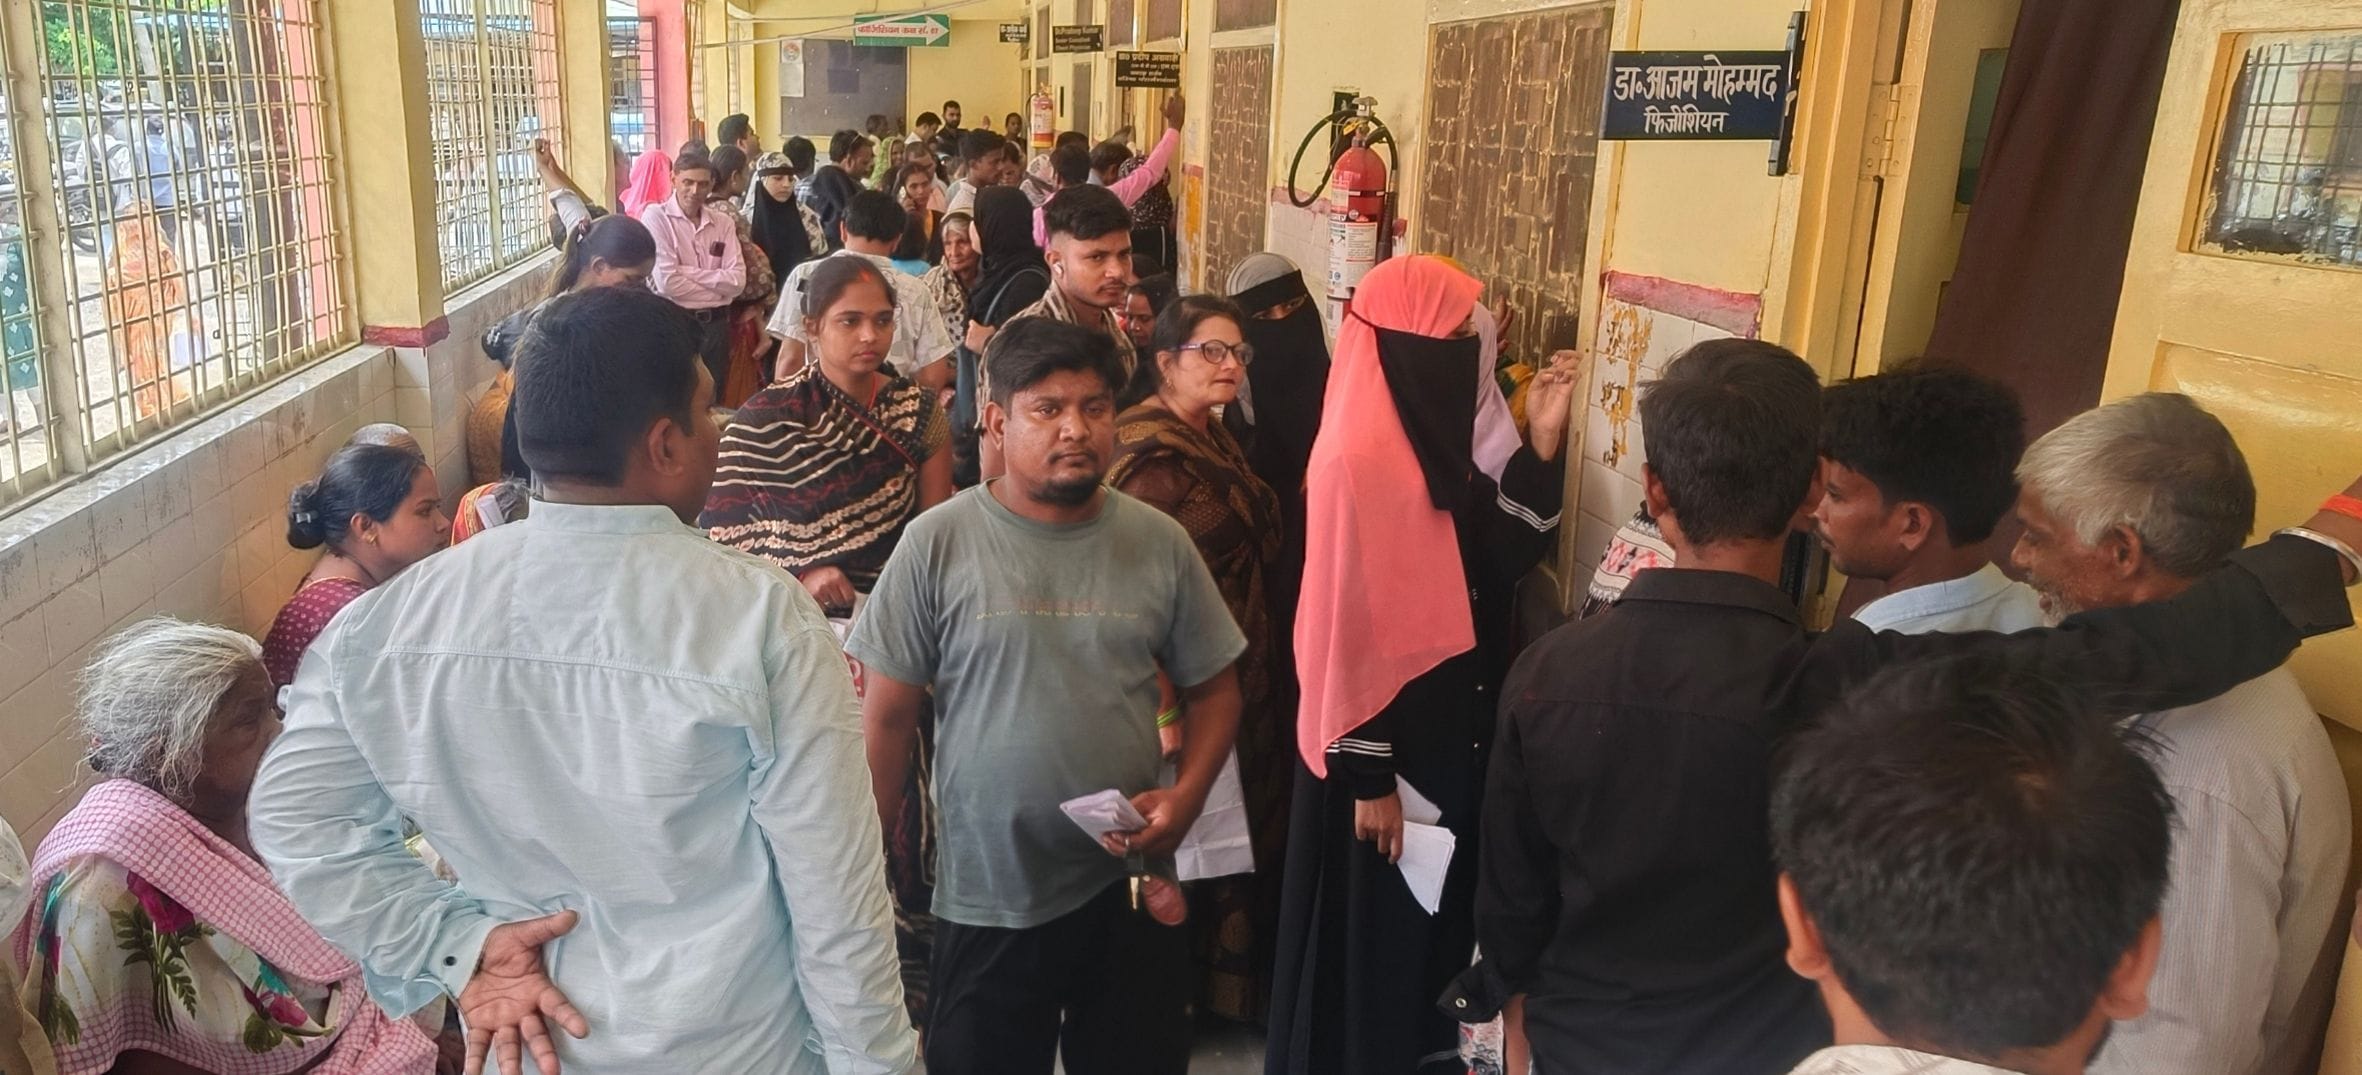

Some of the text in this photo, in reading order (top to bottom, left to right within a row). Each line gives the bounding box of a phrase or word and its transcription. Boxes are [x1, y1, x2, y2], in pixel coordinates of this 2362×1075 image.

[1643, 65, 1703, 100] आजम
[1702, 54, 1782, 105] मोहम्मद
[1643, 103, 1730, 135] फिजीशियन
